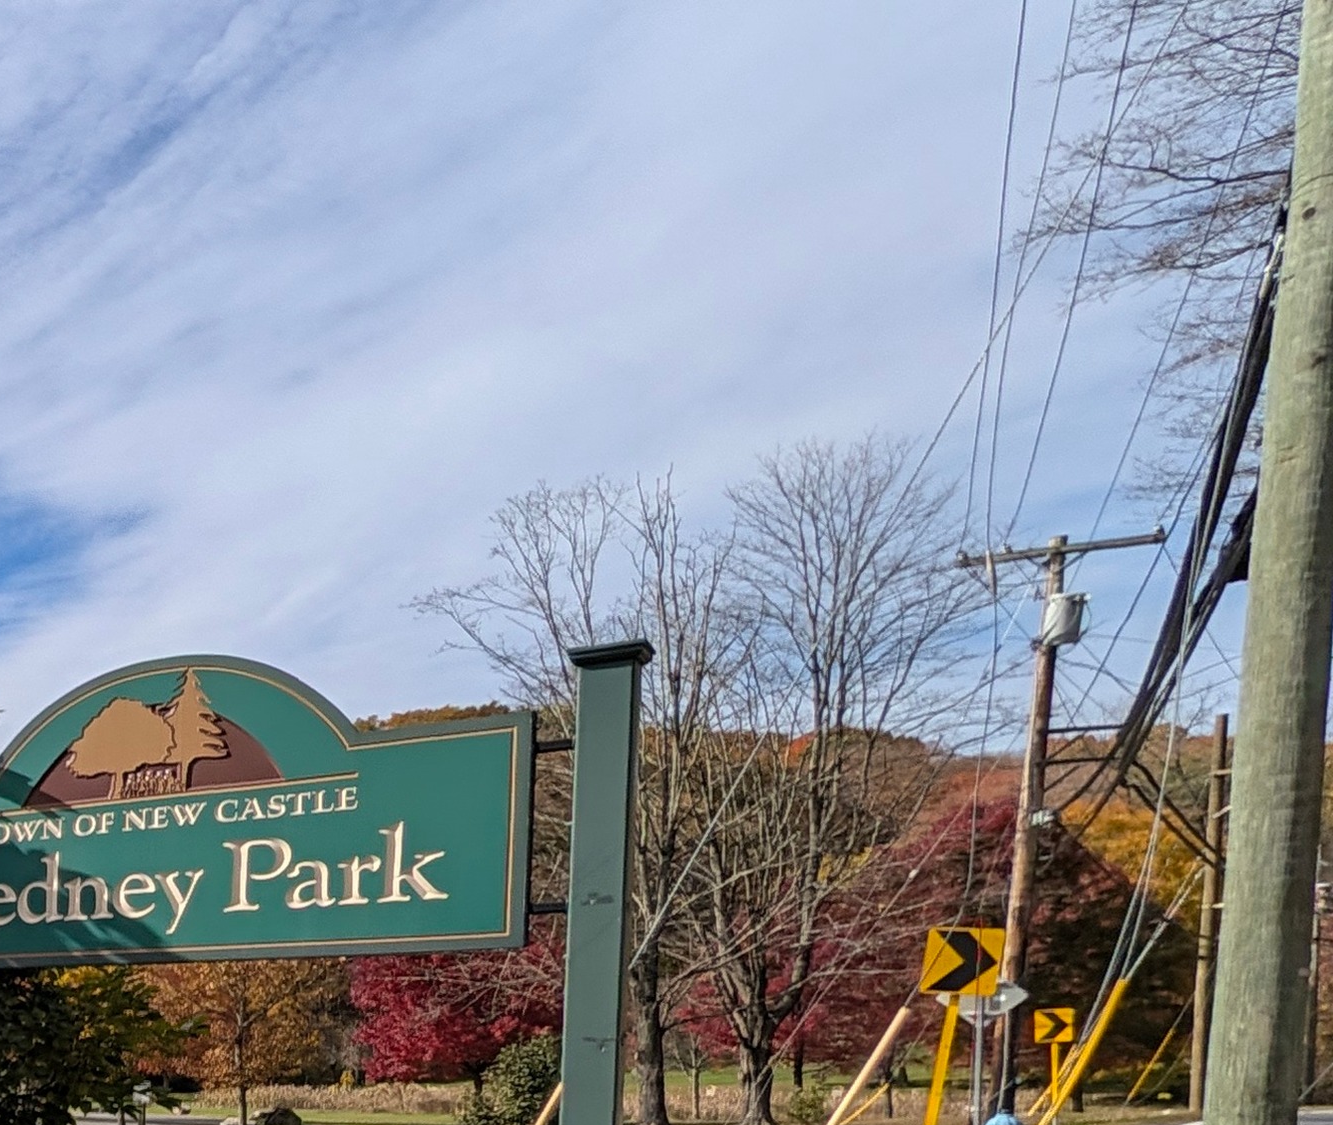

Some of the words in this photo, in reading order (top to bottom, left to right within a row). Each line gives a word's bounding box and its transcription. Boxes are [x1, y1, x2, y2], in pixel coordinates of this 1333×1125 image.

[74, 811, 115, 838] OF
[122, 802, 206, 832] NEW
[213, 786, 359, 824] CASTLE
[222, 820, 449, 914] Park
